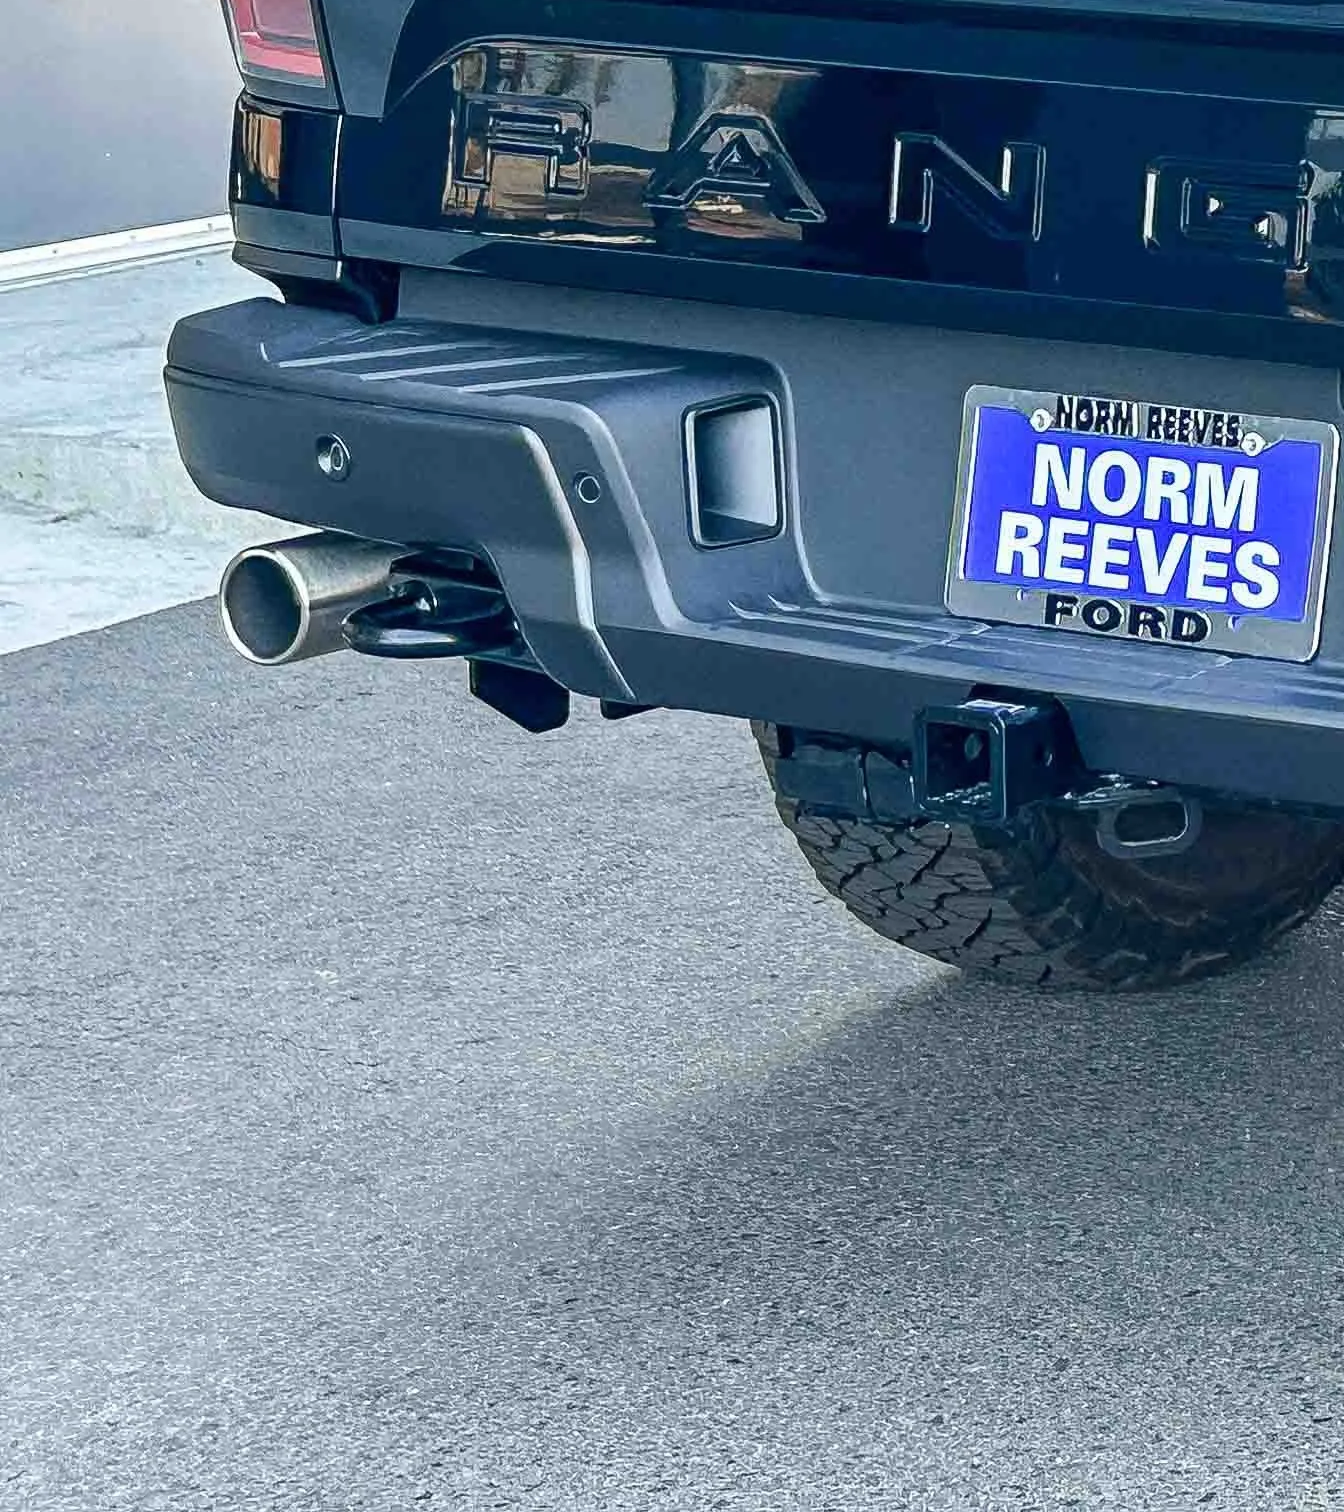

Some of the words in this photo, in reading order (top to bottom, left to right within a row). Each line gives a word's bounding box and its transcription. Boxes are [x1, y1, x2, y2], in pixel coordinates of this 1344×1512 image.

[1055, 394, 1138, 437] NORM
[1146, 405, 1245, 448] REEVES
[1031, 442, 1260, 533] NORM
[994, 510, 1281, 610] REEVES
[1044, 593, 1213, 644] FORD
